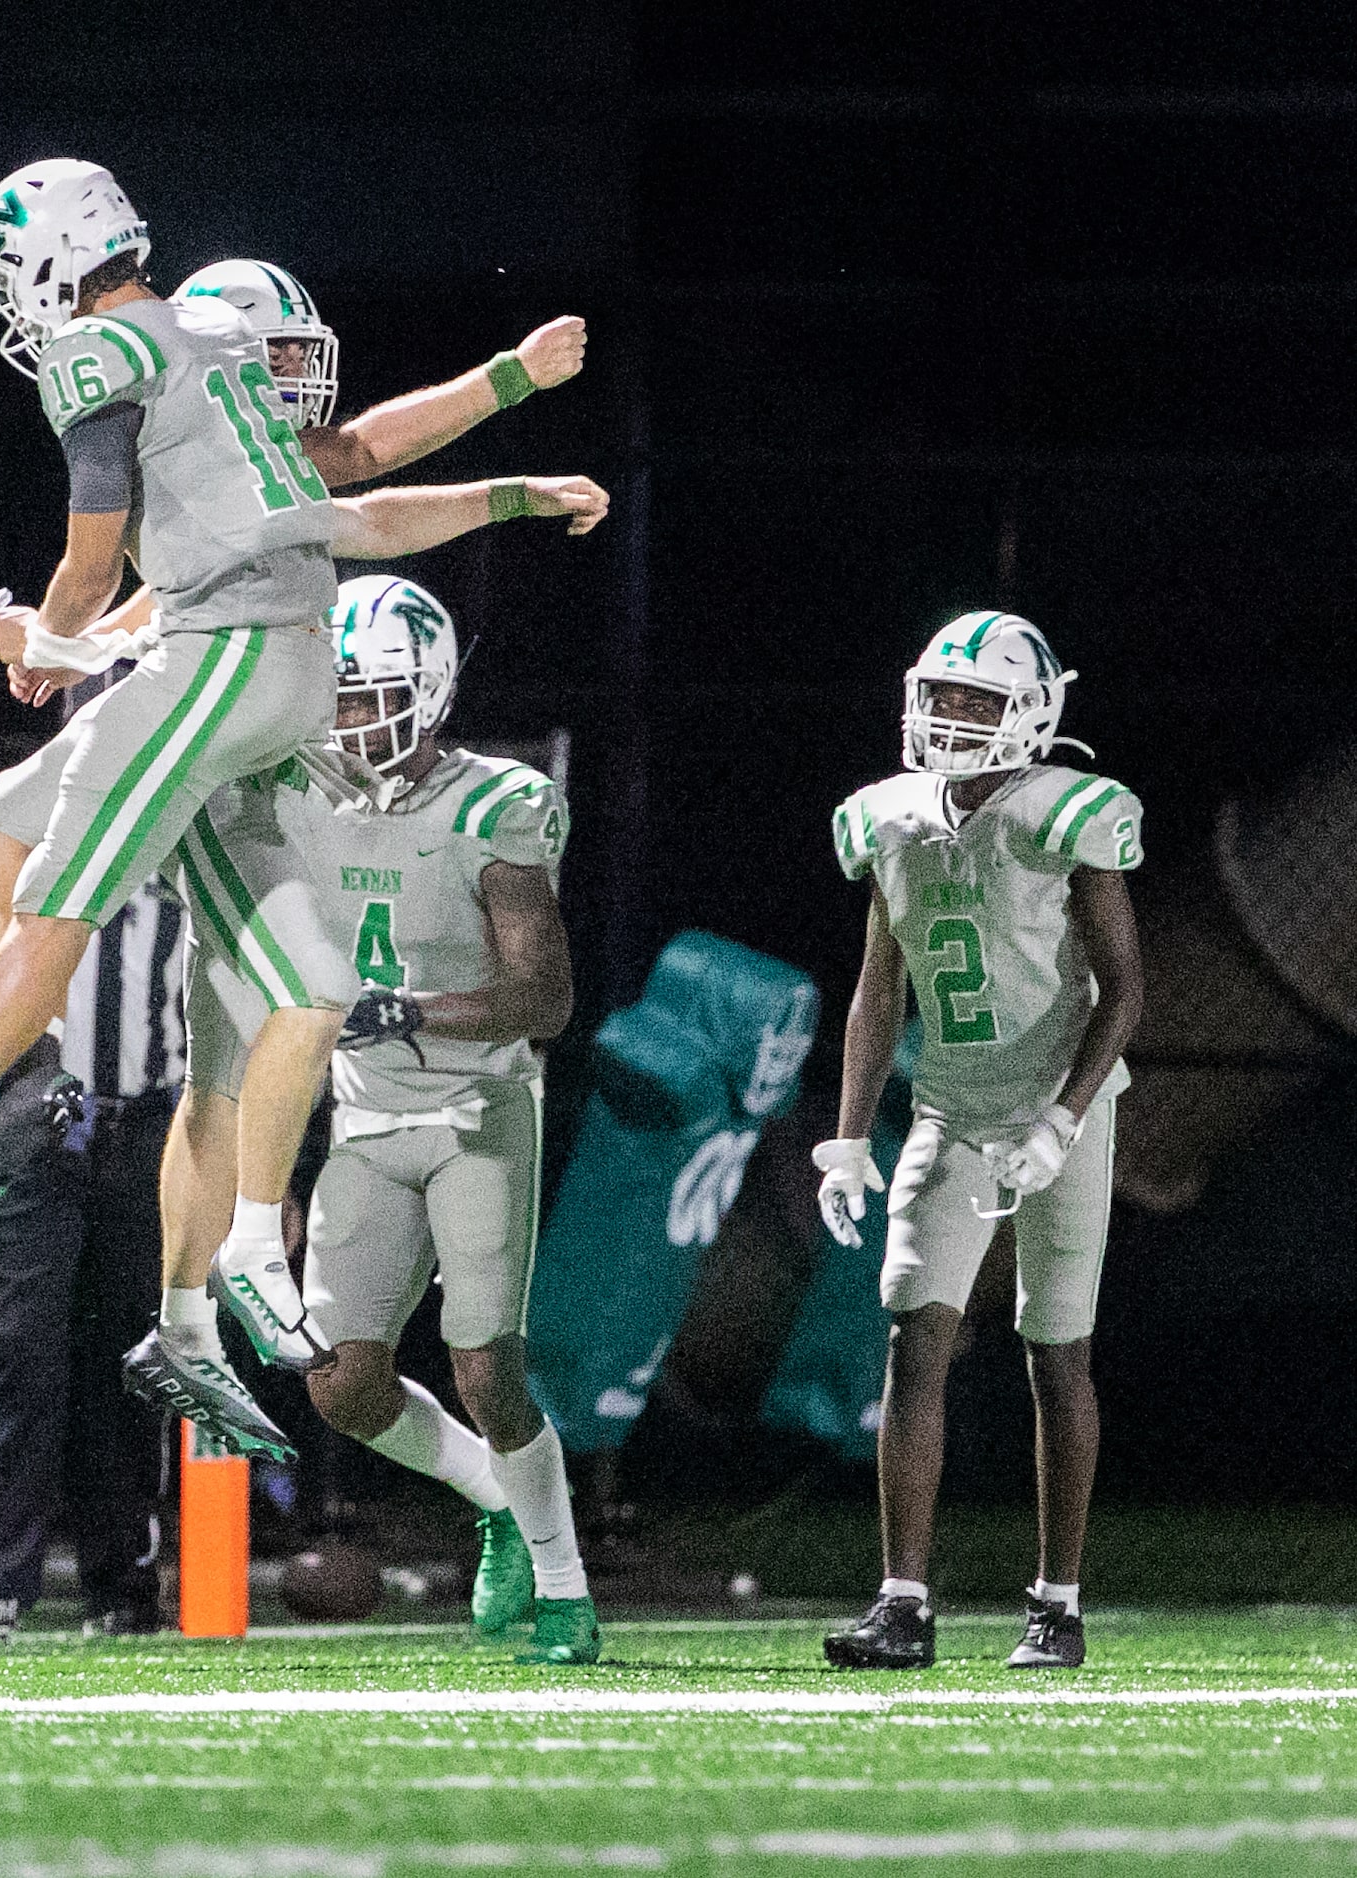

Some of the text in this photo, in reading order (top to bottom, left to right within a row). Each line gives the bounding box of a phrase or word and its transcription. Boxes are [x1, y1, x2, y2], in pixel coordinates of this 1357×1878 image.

[45, 353, 110, 415] 16
[201, 357, 332, 517] 16
[540, 804, 562, 857] 4
[1112, 815, 1139, 868] 2
[340, 864, 403, 895] NEWMAN
[352, 898, 409, 989] 4
[926, 915, 1002, 1045] 2
